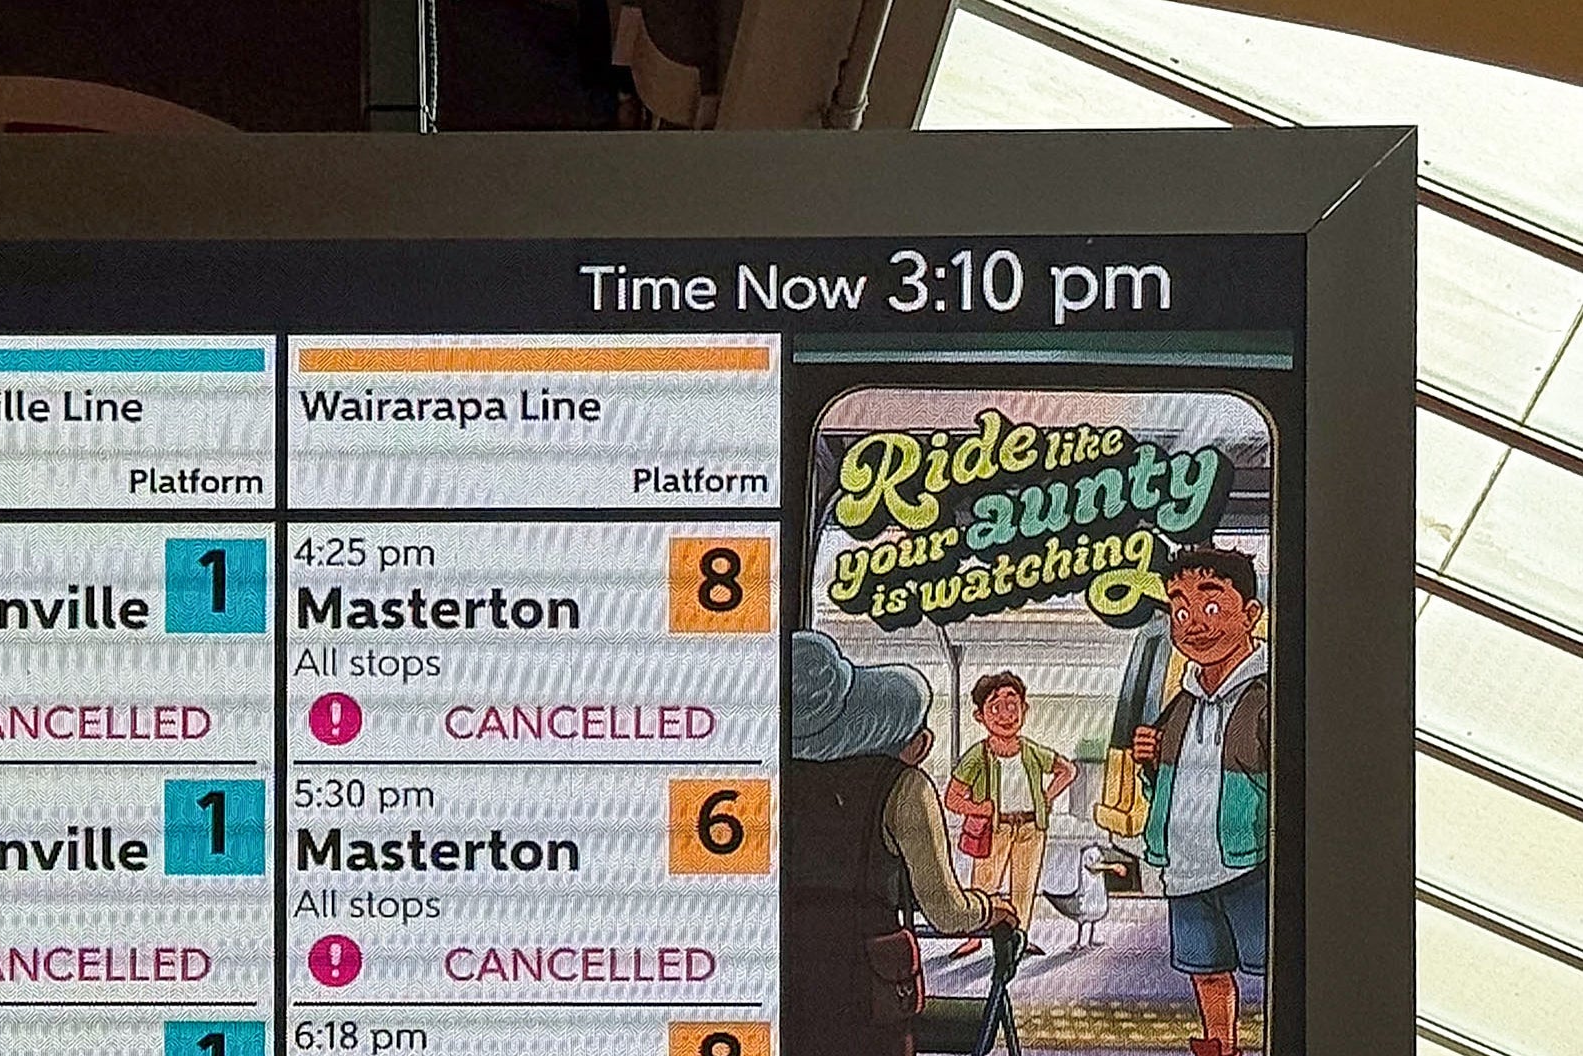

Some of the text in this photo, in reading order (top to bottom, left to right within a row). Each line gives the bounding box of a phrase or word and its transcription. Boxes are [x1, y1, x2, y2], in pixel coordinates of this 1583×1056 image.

[581, 251, 1170, 324] Time Now 3:10 pm
[64, 389, 142, 422] Line
[300, 388, 600, 429] Wairarapa Line
[131, 468, 262, 493] Platform
[634, 467, 767, 492] Platform
[835, 408, 1124, 529] Ride like
[832, 442, 1219, 601] your aunty
[295, 538, 434, 572] 4:25 pm
[871, 529, 1170, 617] is watching
[199, 550, 225, 612] 1
[698, 548, 742, 612] 8
[298, 587, 579, 629] Masterton
[294, 646, 440, 684] All stops
[445, 705, 715, 739] CANCELLED
[295, 779, 433, 813] 5:30 pm
[199, 792, 225, 853] 1
[697, 790, 744, 854] 6
[298, 829, 578, 871] Masterton
[294, 889, 440, 925] All stops
[445, 947, 715, 981] CANCELLED
[295, 1021, 426, 1055] 6:18 pm
